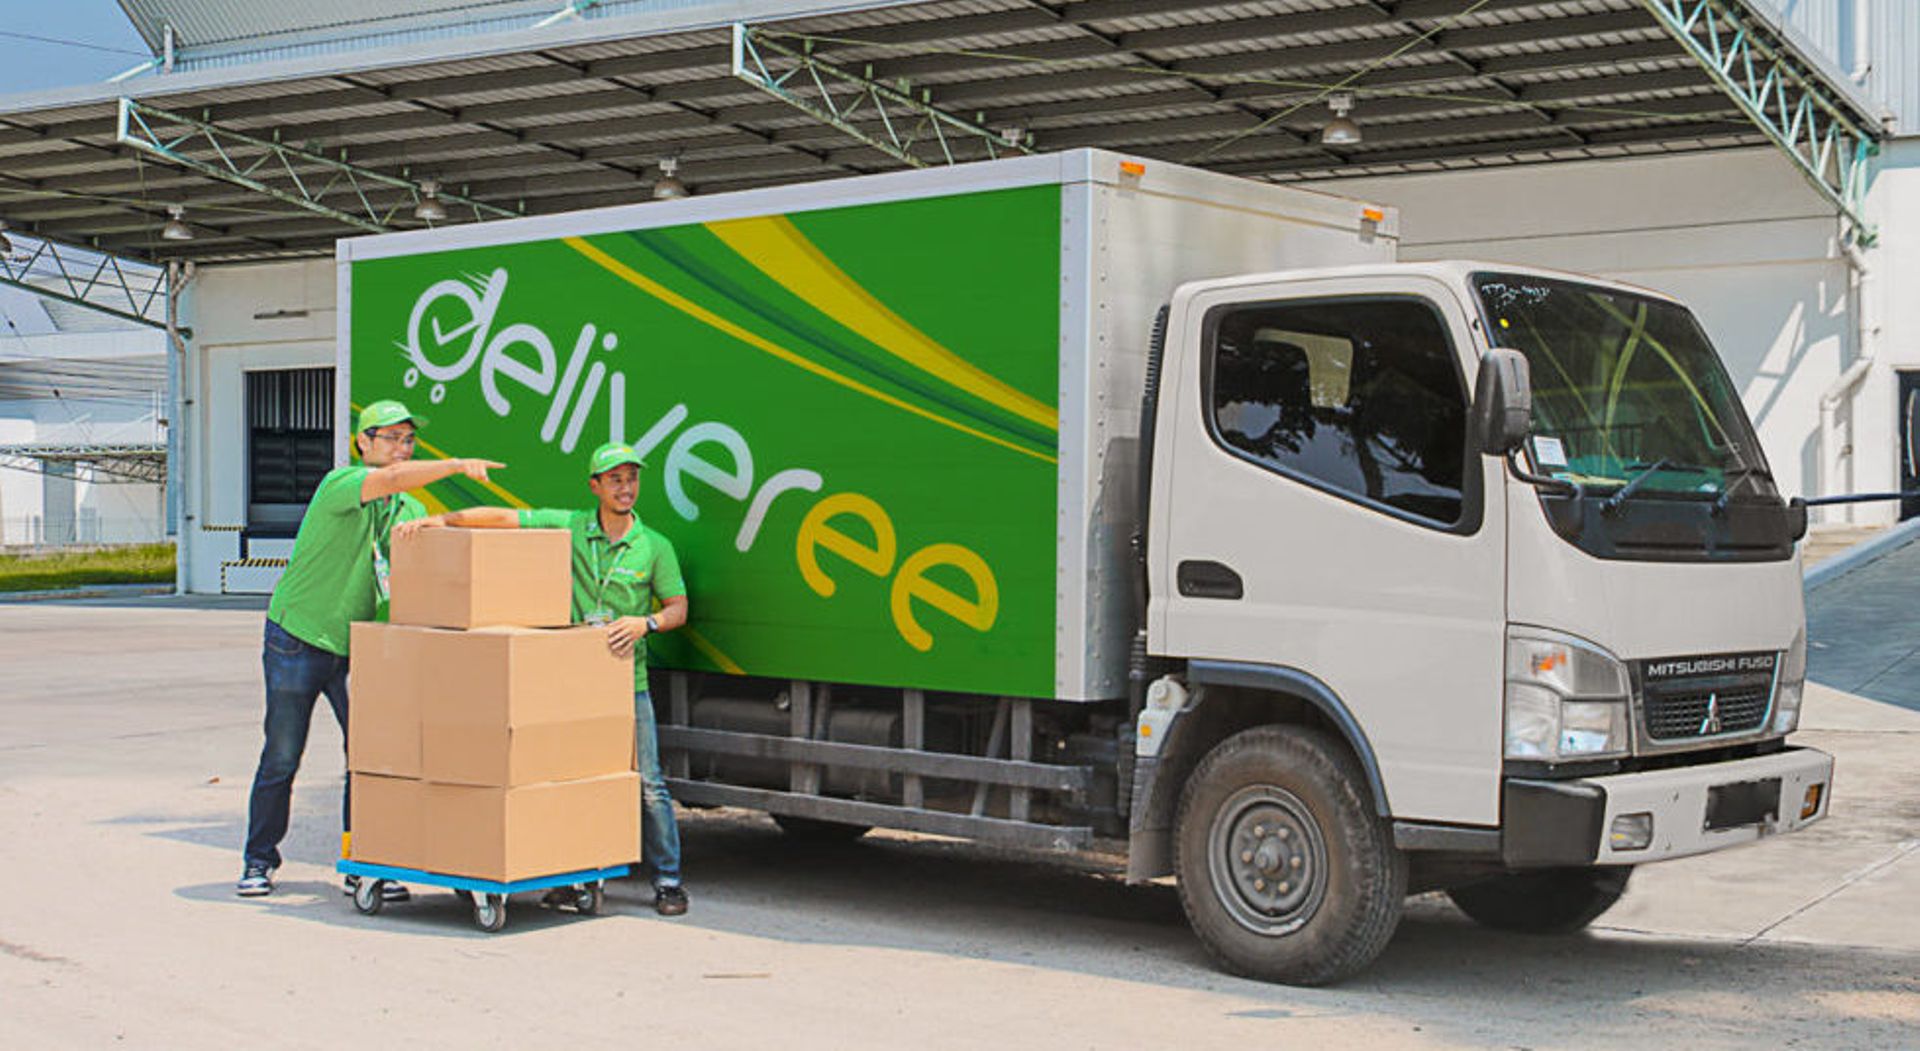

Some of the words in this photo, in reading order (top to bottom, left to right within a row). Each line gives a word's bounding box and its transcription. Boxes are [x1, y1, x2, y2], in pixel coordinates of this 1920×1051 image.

[402, 267, 999, 652] deliveree
[1647, 658, 1736, 677] MITSUBISHI
[1738, 655, 1774, 670] FUSO
